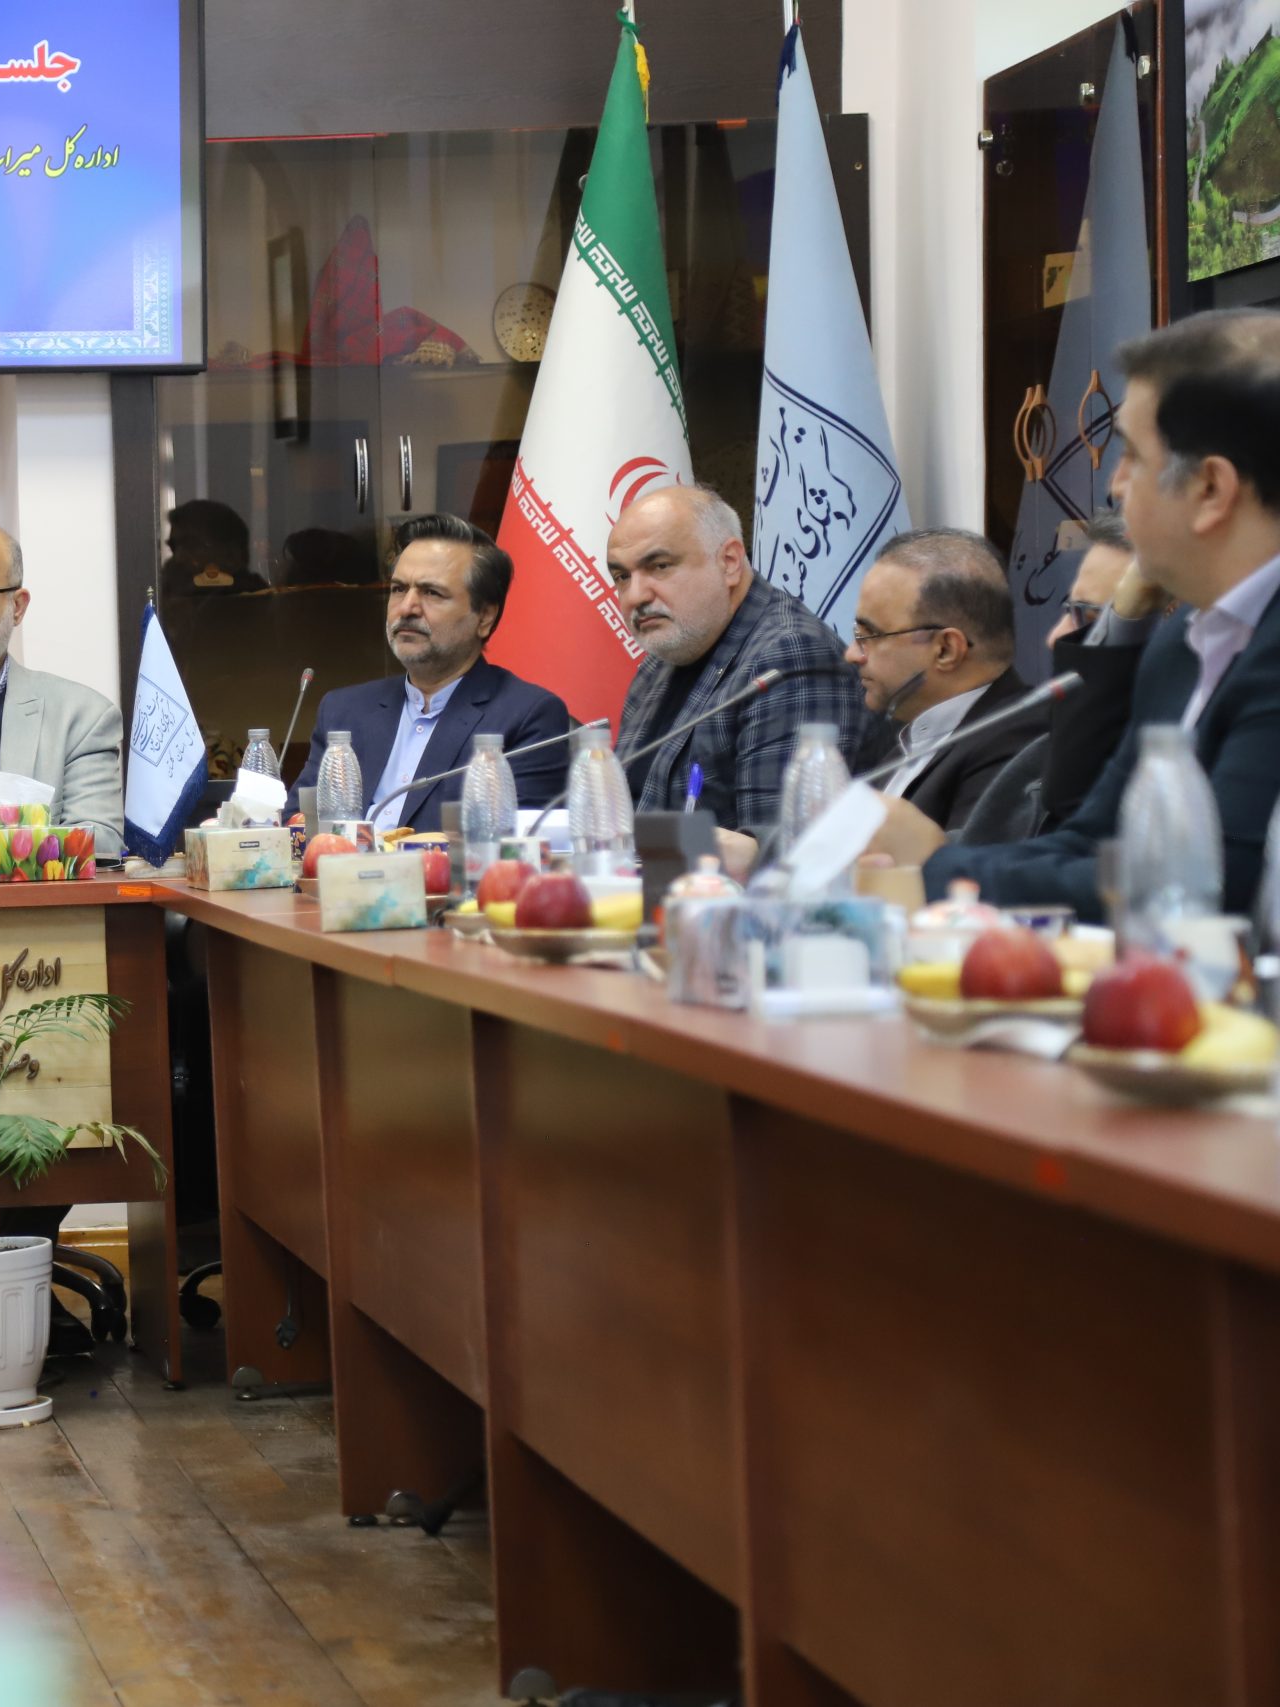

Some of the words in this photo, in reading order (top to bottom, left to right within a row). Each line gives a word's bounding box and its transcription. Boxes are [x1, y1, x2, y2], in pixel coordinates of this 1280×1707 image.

[44, 124, 88, 178] کل
[73, 144, 120, 169] اداره
[16, 956, 62, 992] اداره
